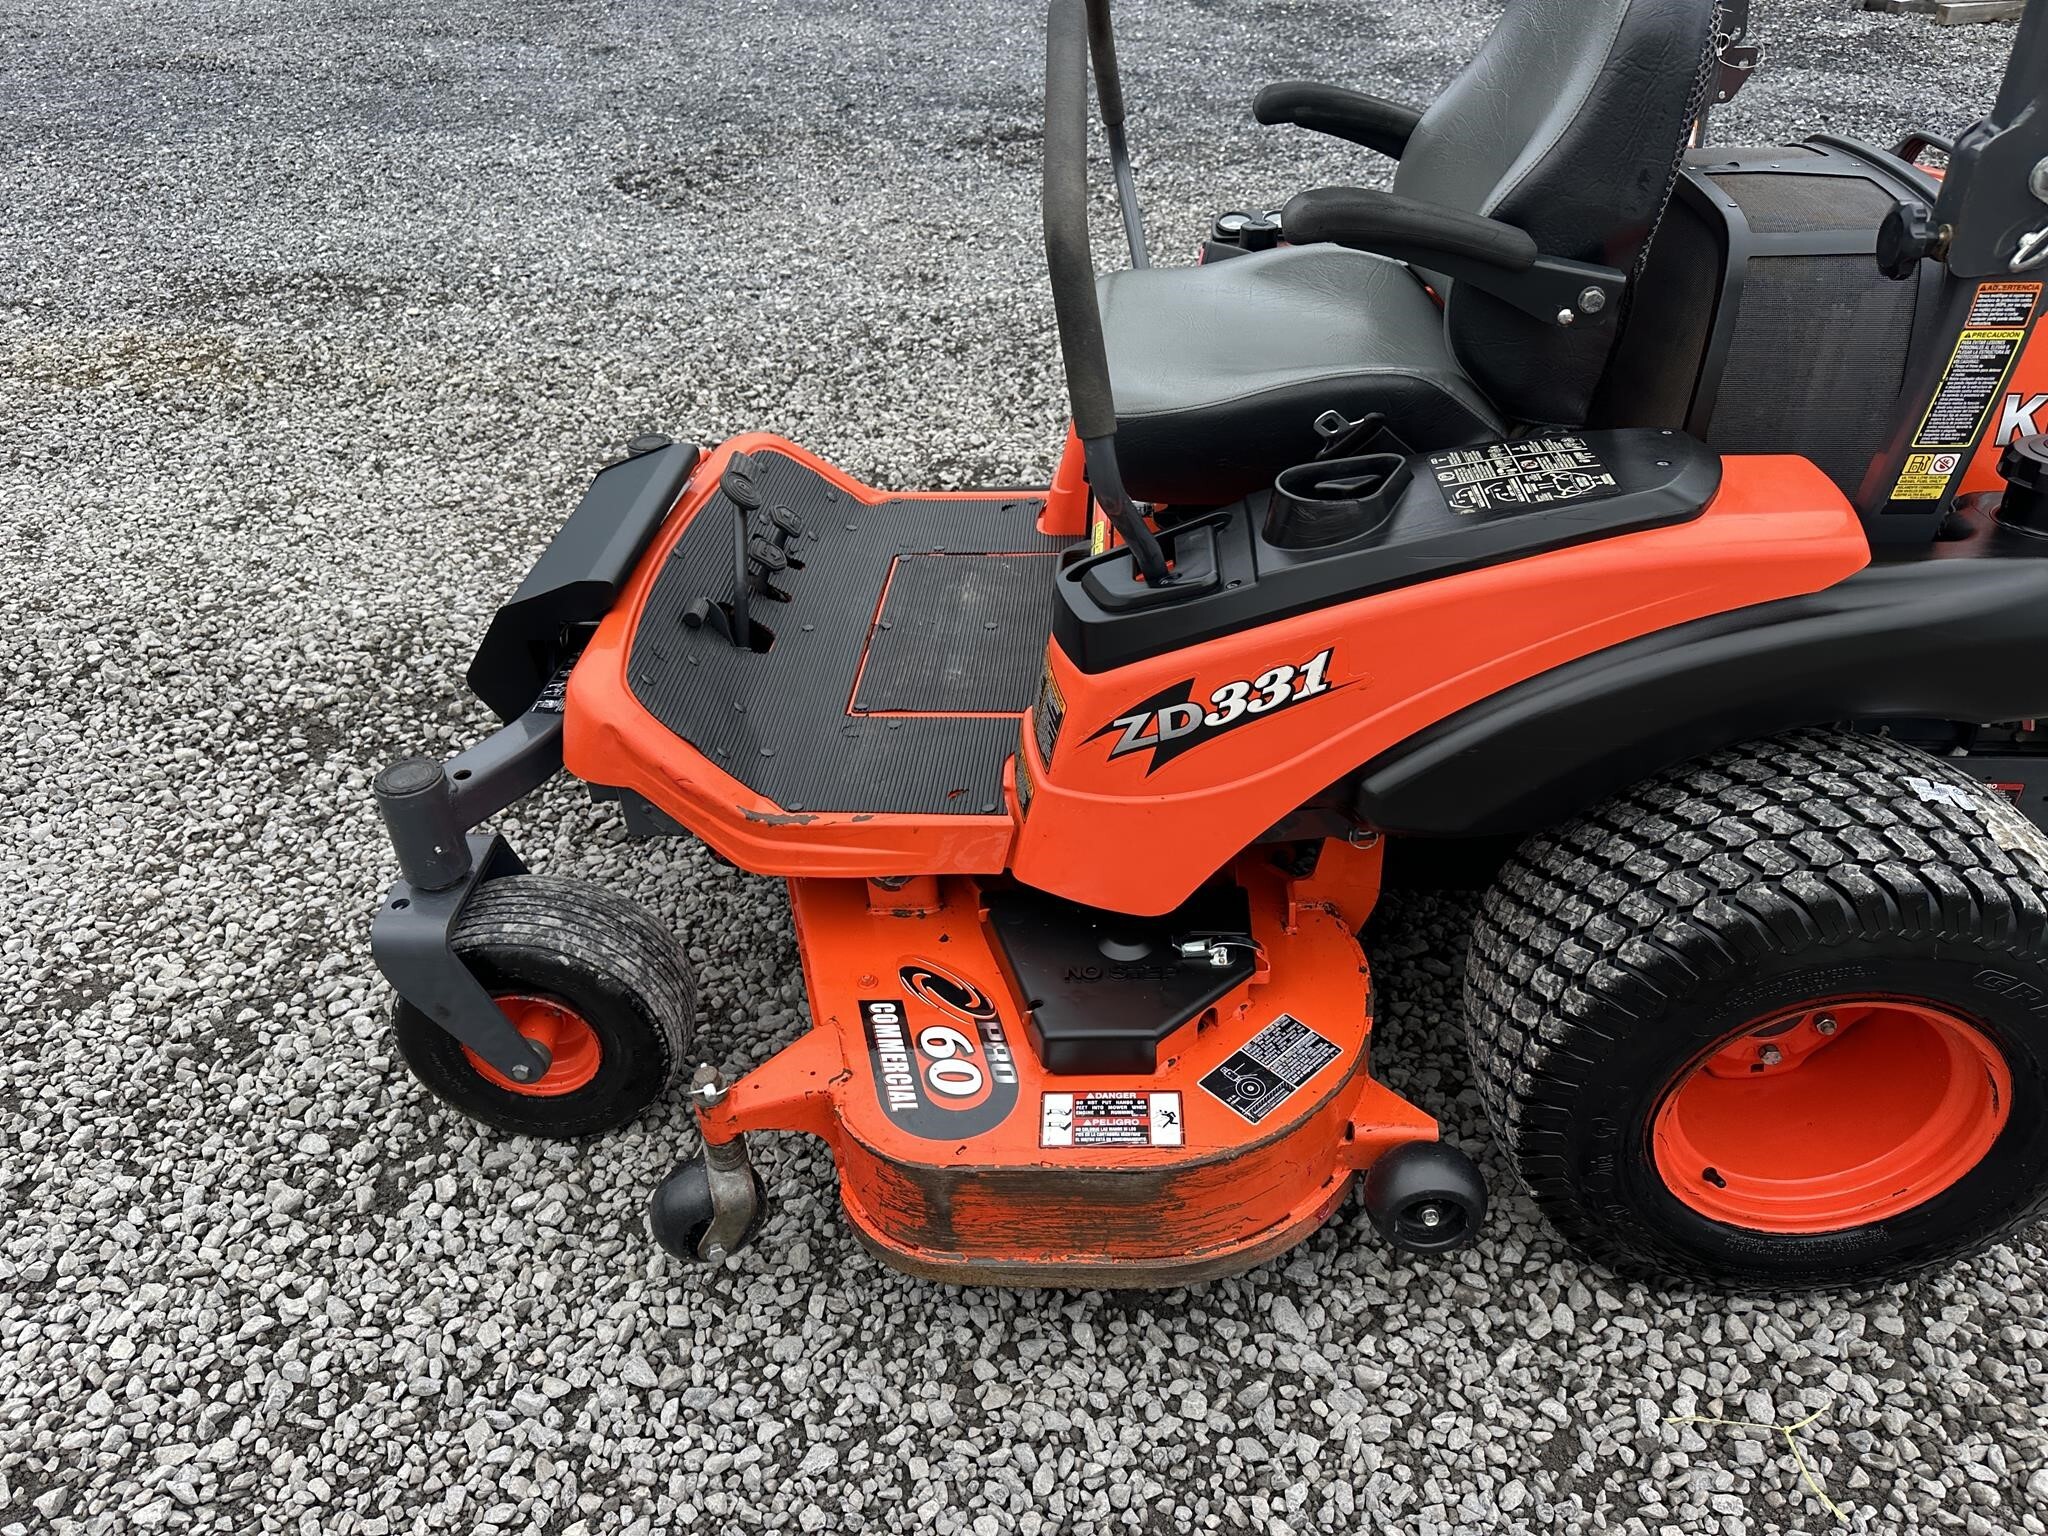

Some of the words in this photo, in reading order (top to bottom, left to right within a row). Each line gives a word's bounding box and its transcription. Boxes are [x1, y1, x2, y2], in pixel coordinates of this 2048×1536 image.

[1108, 649, 1332, 759] ZD331
[1064, 966, 1104, 982] NO
[1108, 965, 1178, 982] STEP
[868, 1002, 919, 1113] COMMERCIAL
[918, 1025, 984, 1098] 60
[977, 1022, 1018, 1084] PRO
